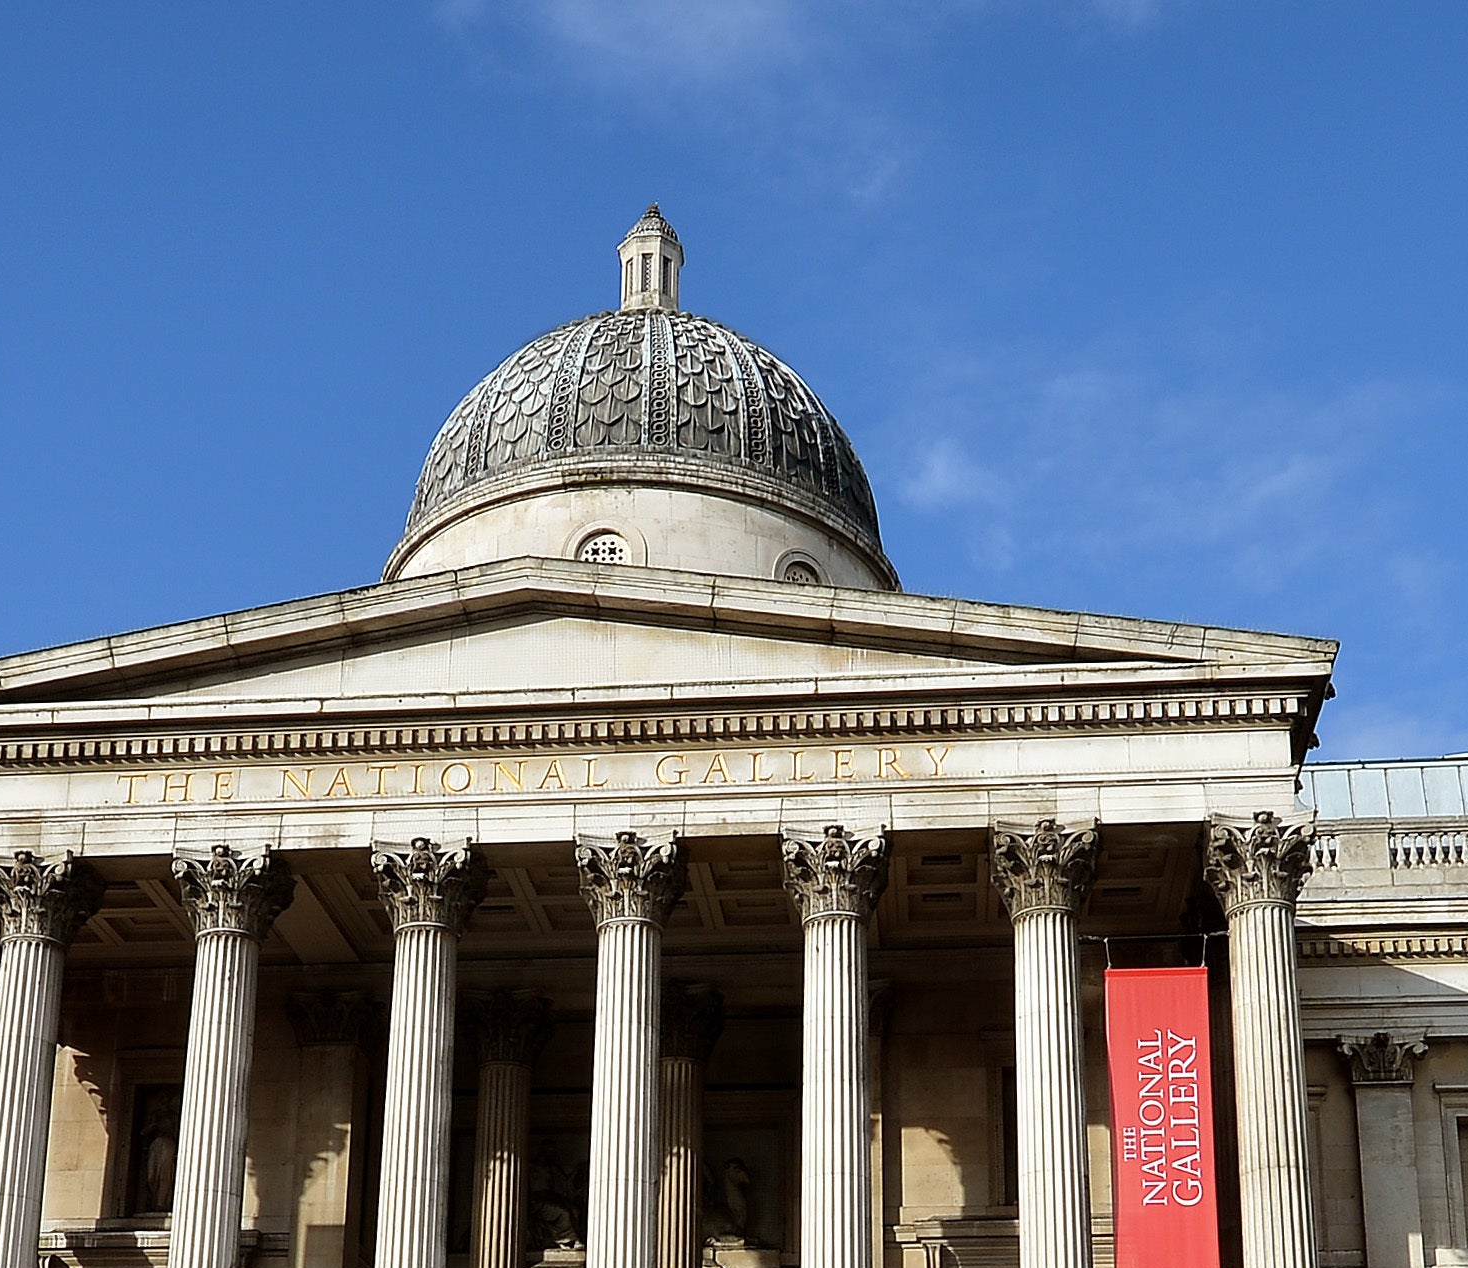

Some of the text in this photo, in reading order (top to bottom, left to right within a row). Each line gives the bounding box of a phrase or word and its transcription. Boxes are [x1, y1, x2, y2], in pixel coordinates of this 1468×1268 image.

[117, 746, 953, 804] THE NATIONAL GALLERY
[1123, 1126, 1136, 1162] THE
[1137, 1029, 1169, 1206] NATIONAL
[1167, 1029, 1204, 1207] GALLERY
